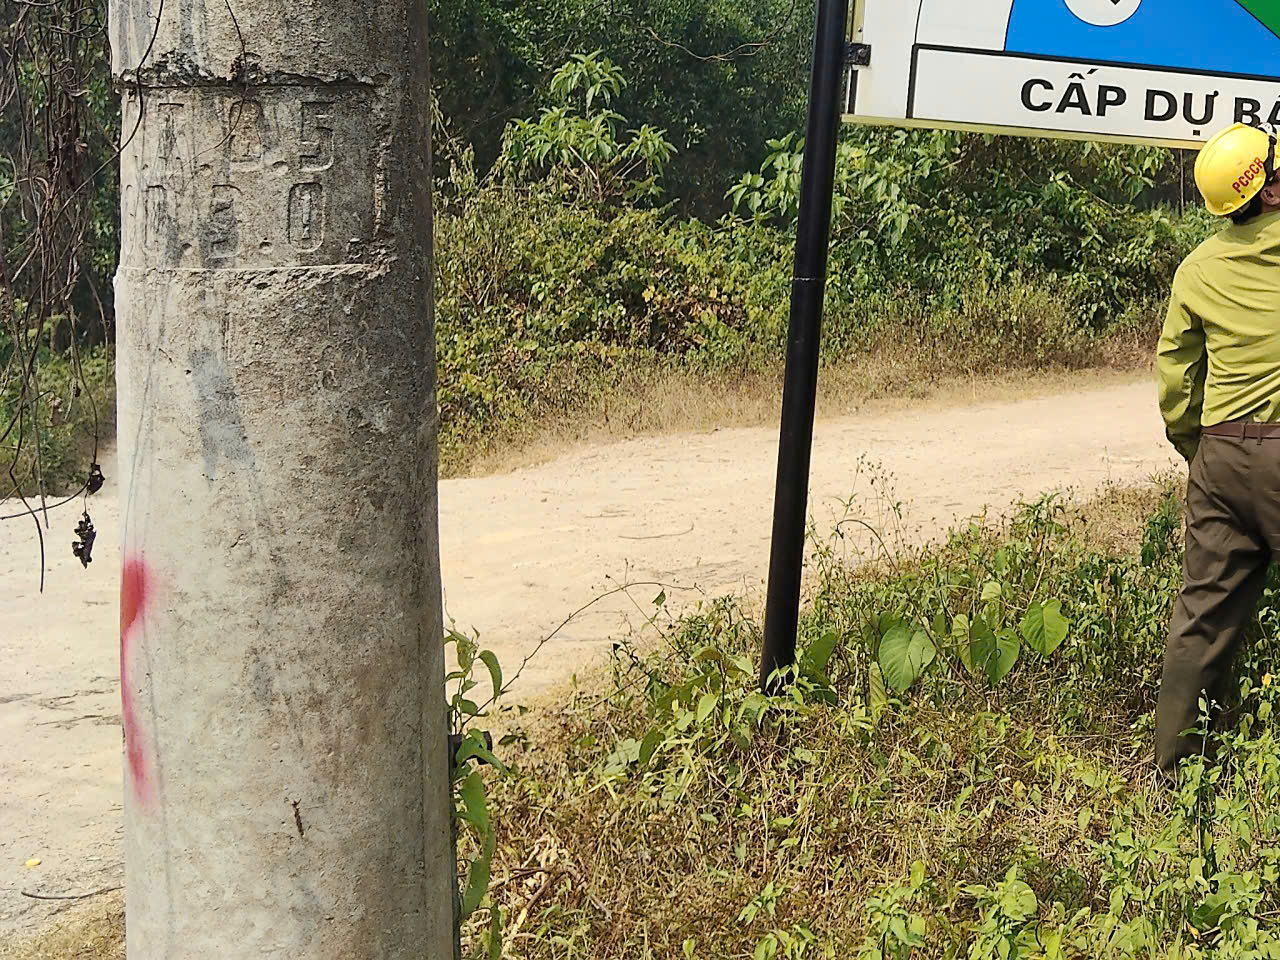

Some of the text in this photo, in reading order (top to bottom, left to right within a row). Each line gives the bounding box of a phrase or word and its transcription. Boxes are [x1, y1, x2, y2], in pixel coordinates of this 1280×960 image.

[1020, 68, 1127, 117] CẤP
[1144, 88, 1219, 136] DỰ
[1231, 156, 1264, 194] PCCCR
